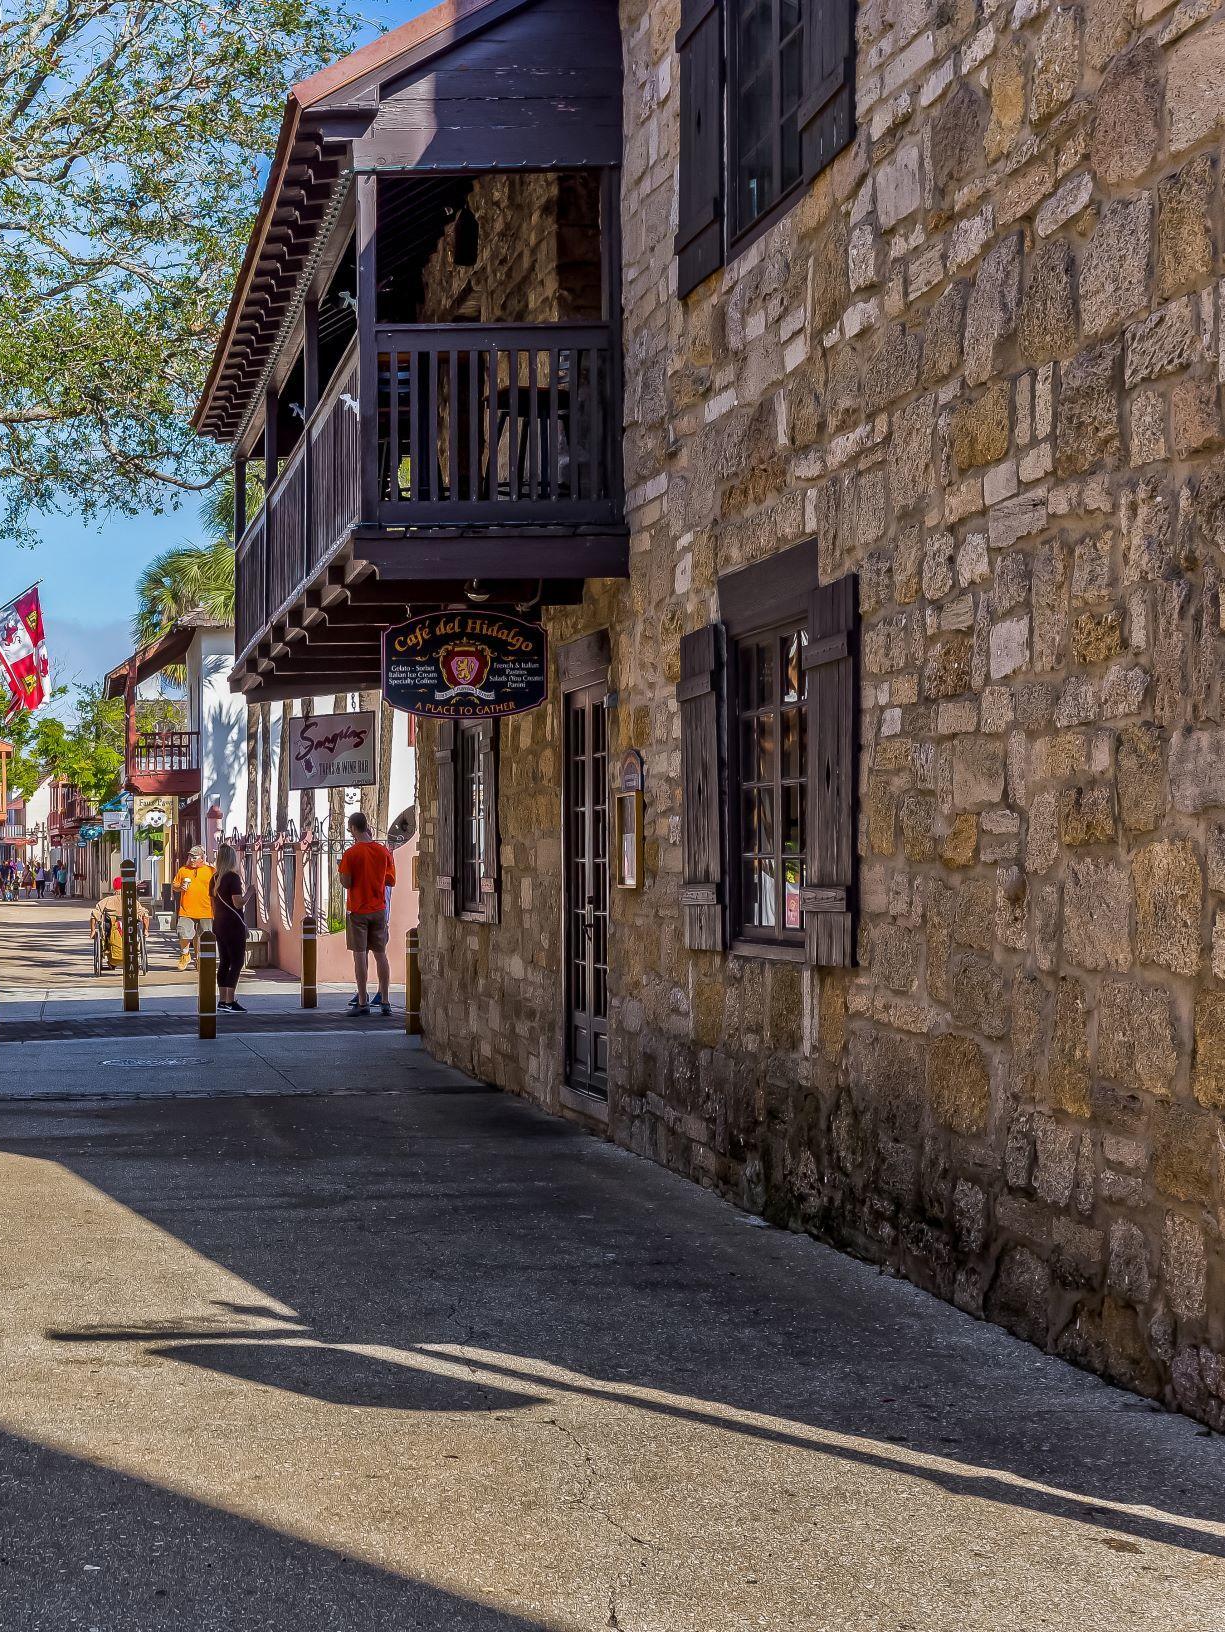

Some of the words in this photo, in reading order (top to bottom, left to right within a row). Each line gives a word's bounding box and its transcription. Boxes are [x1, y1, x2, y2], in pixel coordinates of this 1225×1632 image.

[395, 620, 432, 651] Café
[436, 617, 462, 636] del
[466, 619, 533, 651] Hidalgo
[415, 702, 422, 711] A
[425, 704, 455, 714] PLACE
[458, 706, 473, 715] TO
[476, 701, 516, 714] GATHER
[319, 762, 335, 776] TAPAS
[341, 761, 356, 775] WINE
[357, 759, 369, 774] BAR
[127, 897, 135, 971] HYPOLITA
